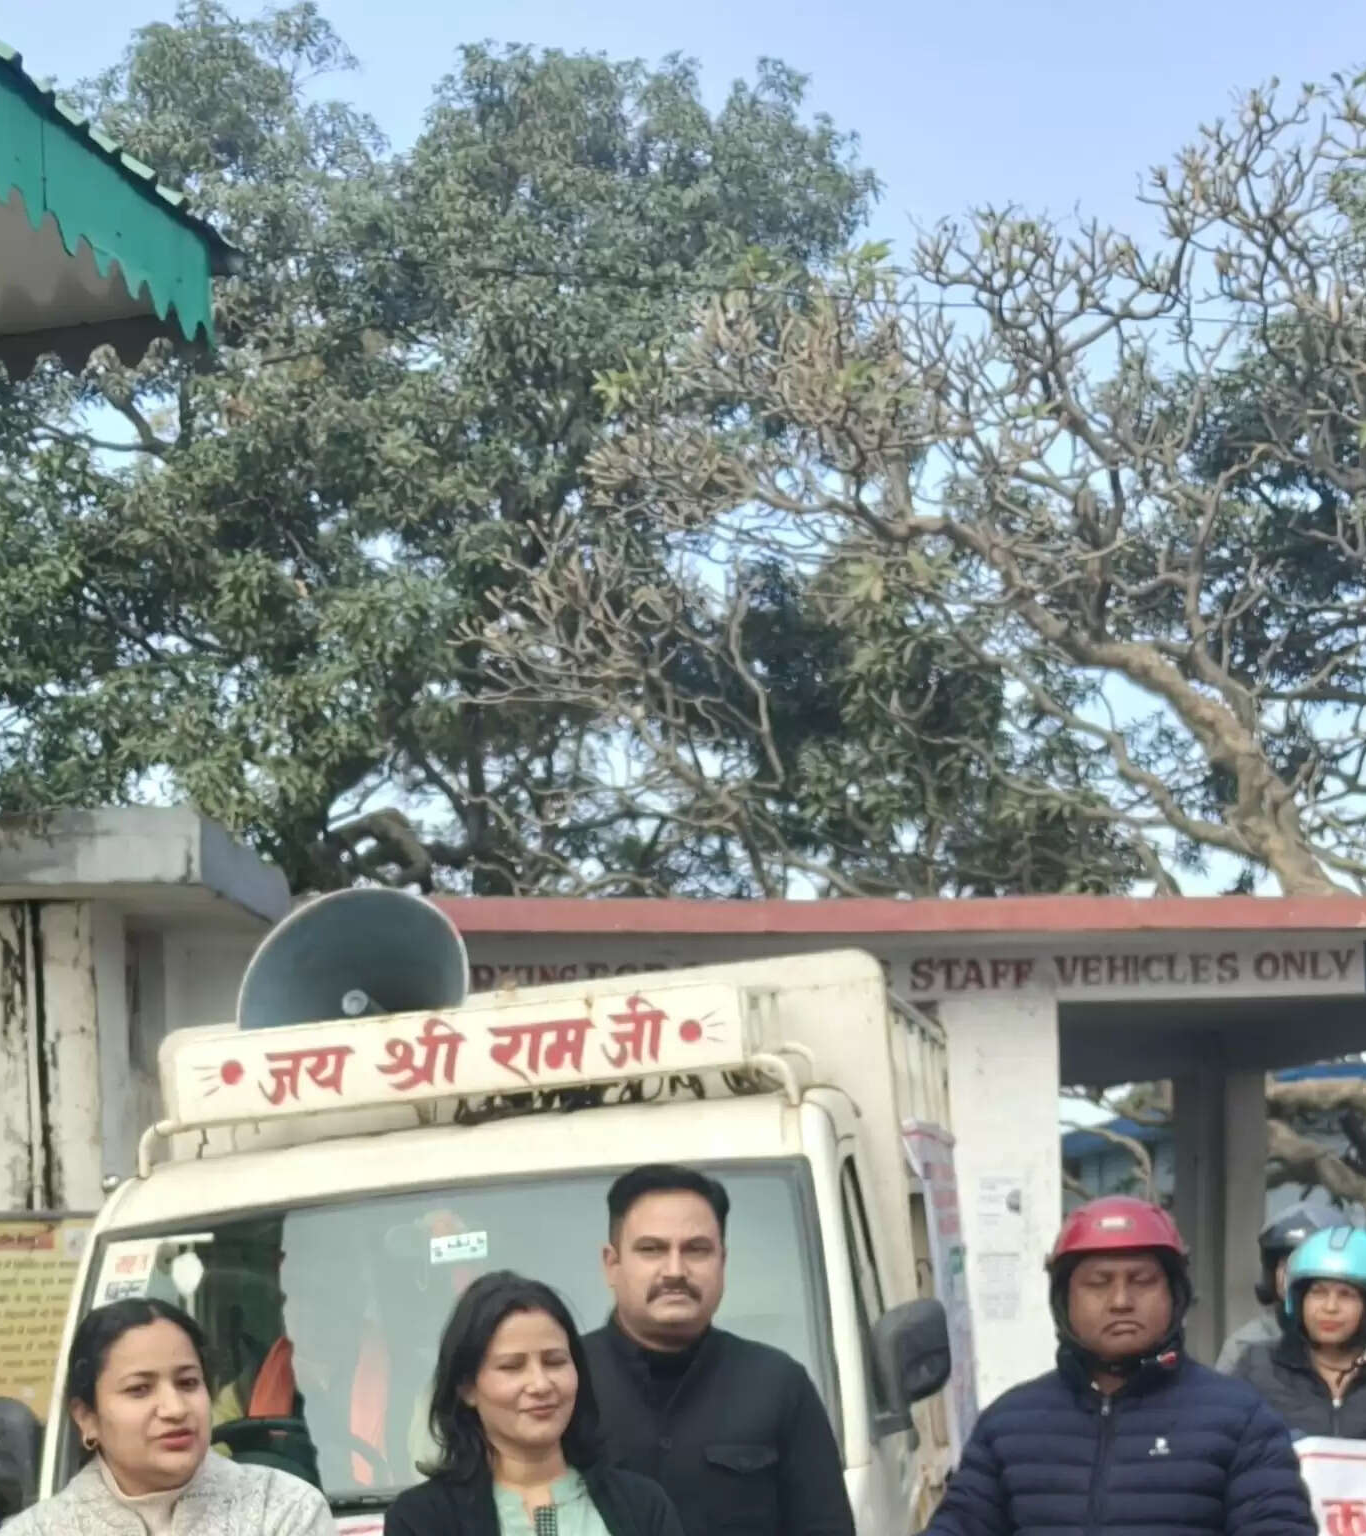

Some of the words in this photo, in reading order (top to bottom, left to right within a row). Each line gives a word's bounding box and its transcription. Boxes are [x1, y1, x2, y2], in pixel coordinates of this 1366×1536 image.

[910, 957, 1033, 992] STAFF
[1053, 952, 1239, 986] VEHICLES
[1253, 948, 1356, 980] ONLY
[258, 1045, 355, 1106] जय
[377, 1018, 465, 1091] श्री
[488, 1018, 597, 1084] राम
[601, 996, 669, 1069] जी
